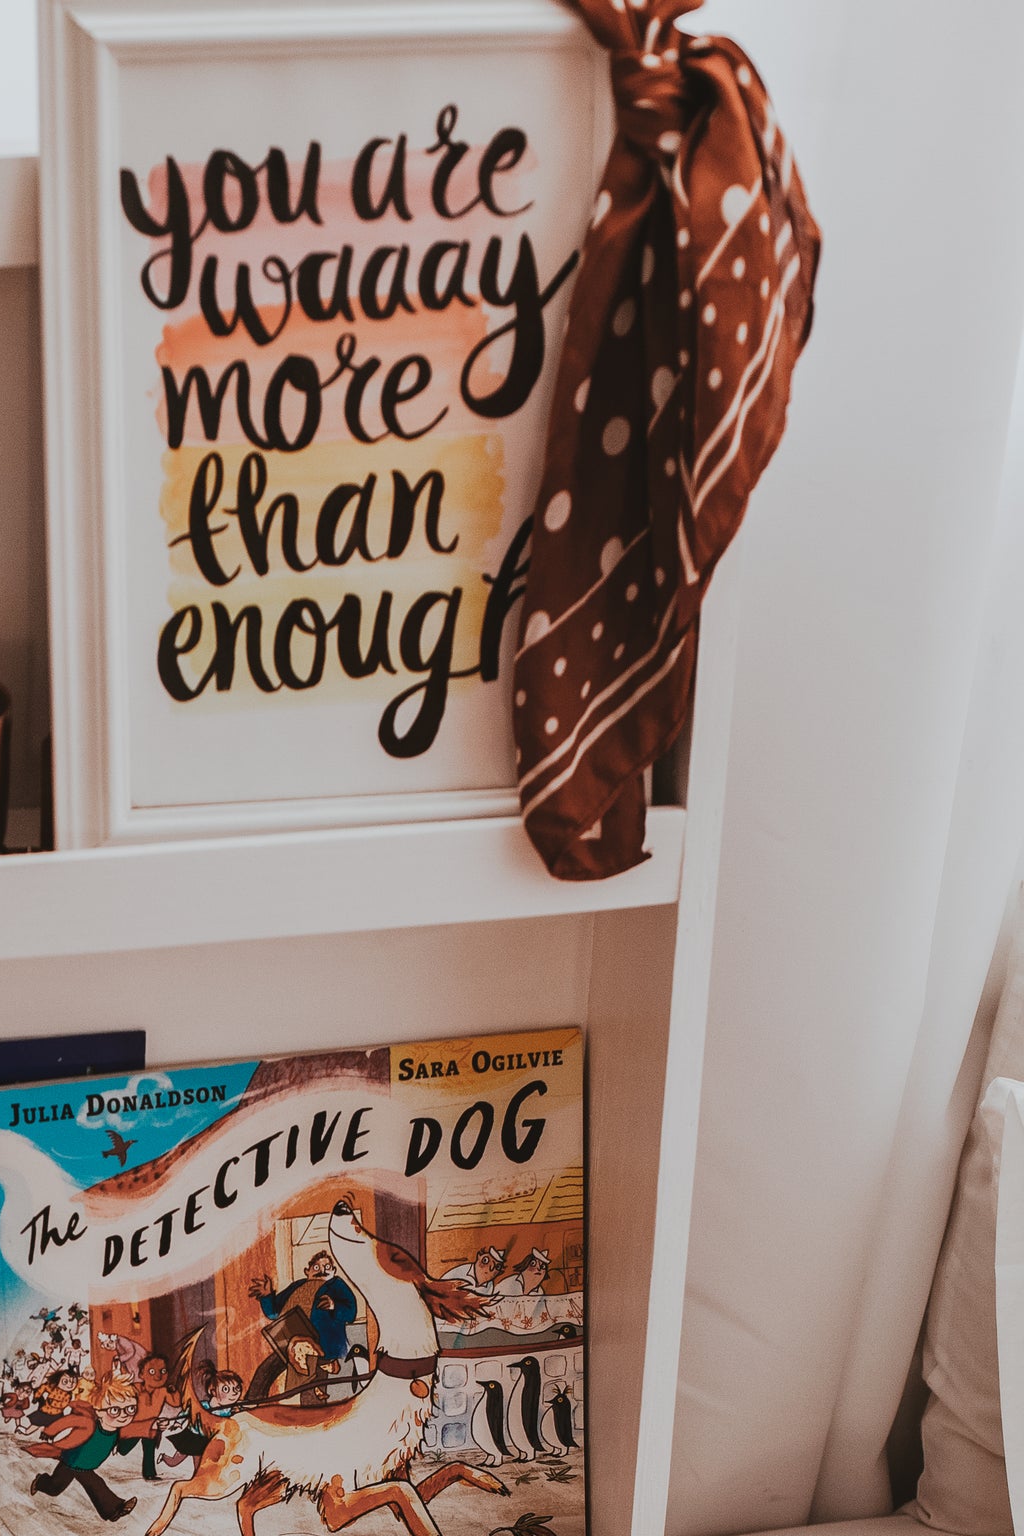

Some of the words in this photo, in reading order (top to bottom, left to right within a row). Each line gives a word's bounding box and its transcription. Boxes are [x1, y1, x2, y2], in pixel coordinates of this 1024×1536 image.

[120, 140, 324, 309] you
[349, 103, 534, 221] are
[199, 233, 579, 418] waaay
[162, 334, 449, 452] more
[169, 452, 459, 586] than
[8, 1102, 74, 1128] JULIA
[85, 1084, 228, 1117] DONALDSON
[398, 1057, 460, 1082] SARA
[470, 1049, 563, 1074] OGILVIE
[20, 1204, 87, 1265] The
[101, 1106, 374, 1278] DETECTIVE
[403, 1079, 548, 1178] DOG
